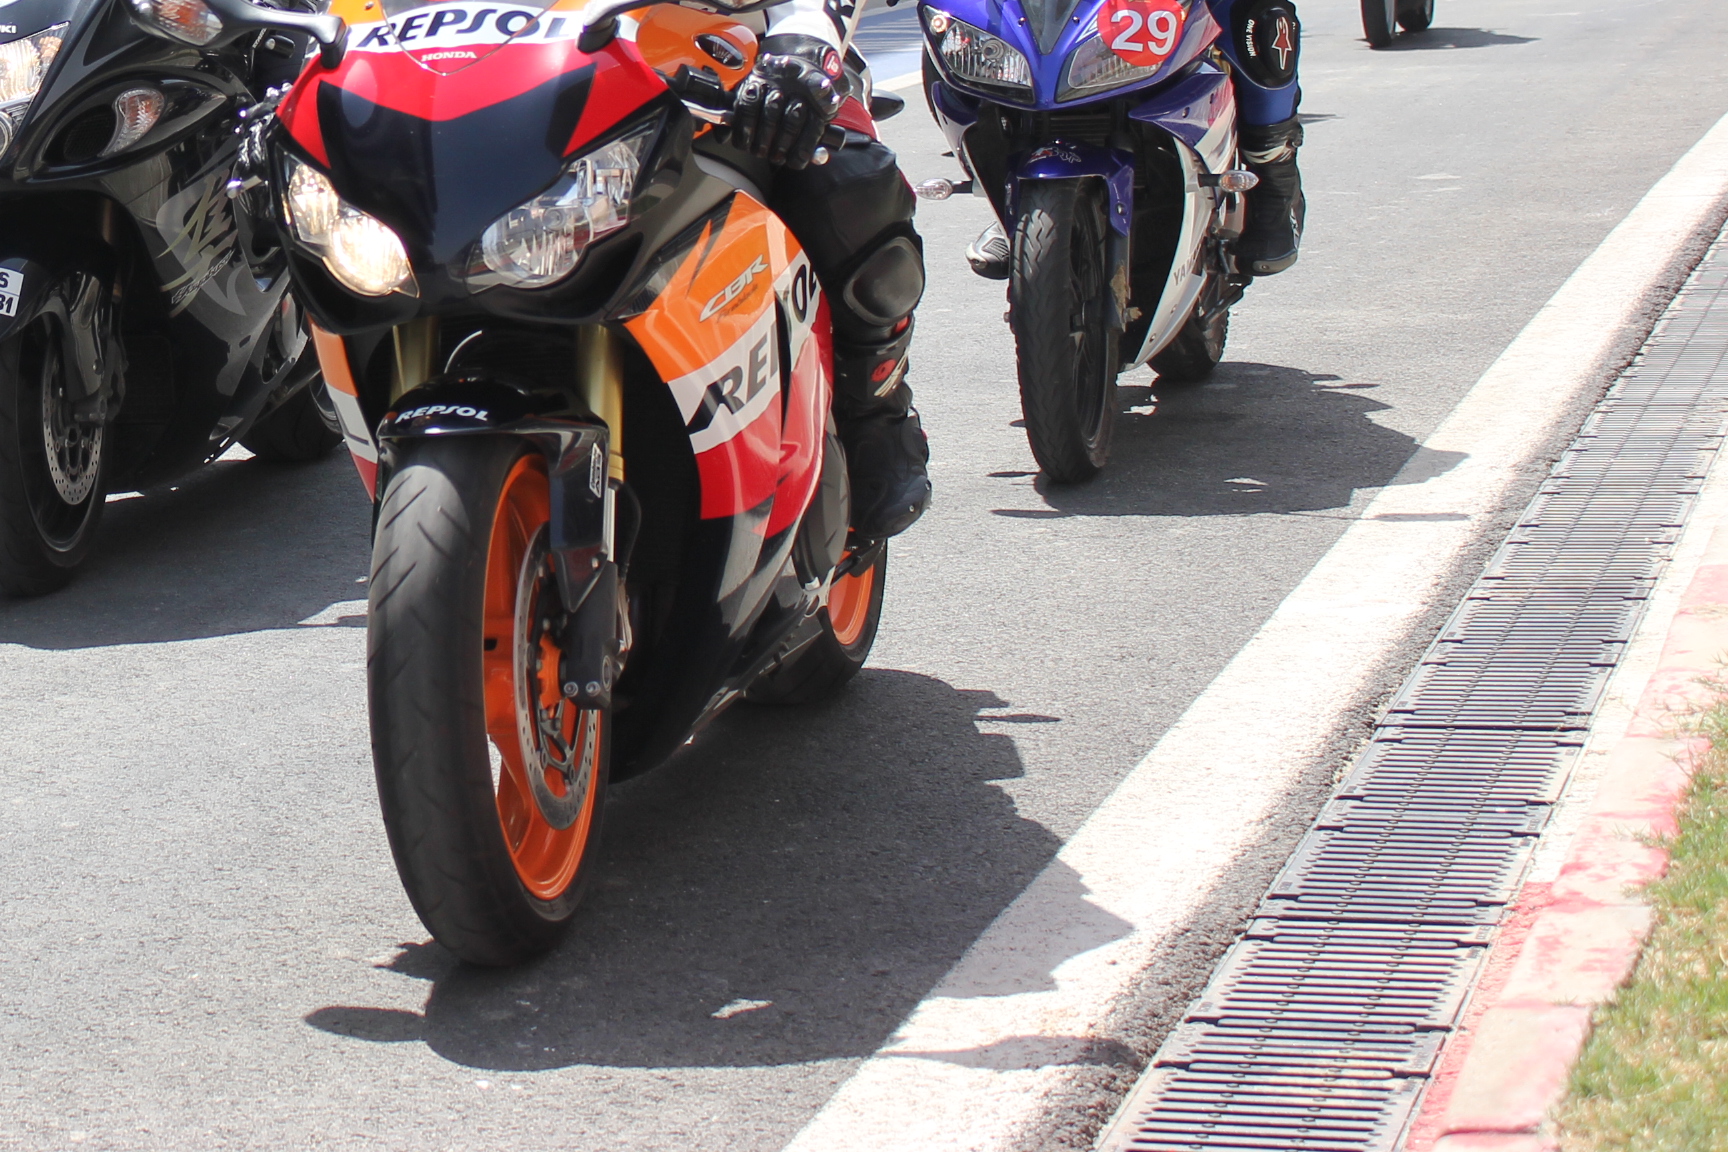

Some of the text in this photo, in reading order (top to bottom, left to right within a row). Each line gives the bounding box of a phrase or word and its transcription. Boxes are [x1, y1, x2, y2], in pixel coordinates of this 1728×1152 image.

[356, 8, 571, 48] REPSOL
[1110, 9, 1178, 56] 29
[1245, 19, 1255, 35] ONE
[421, 51, 478, 62] HONDA
[699, 253, 769, 323] CBR
[394, 405, 489, 425] REPSOL
